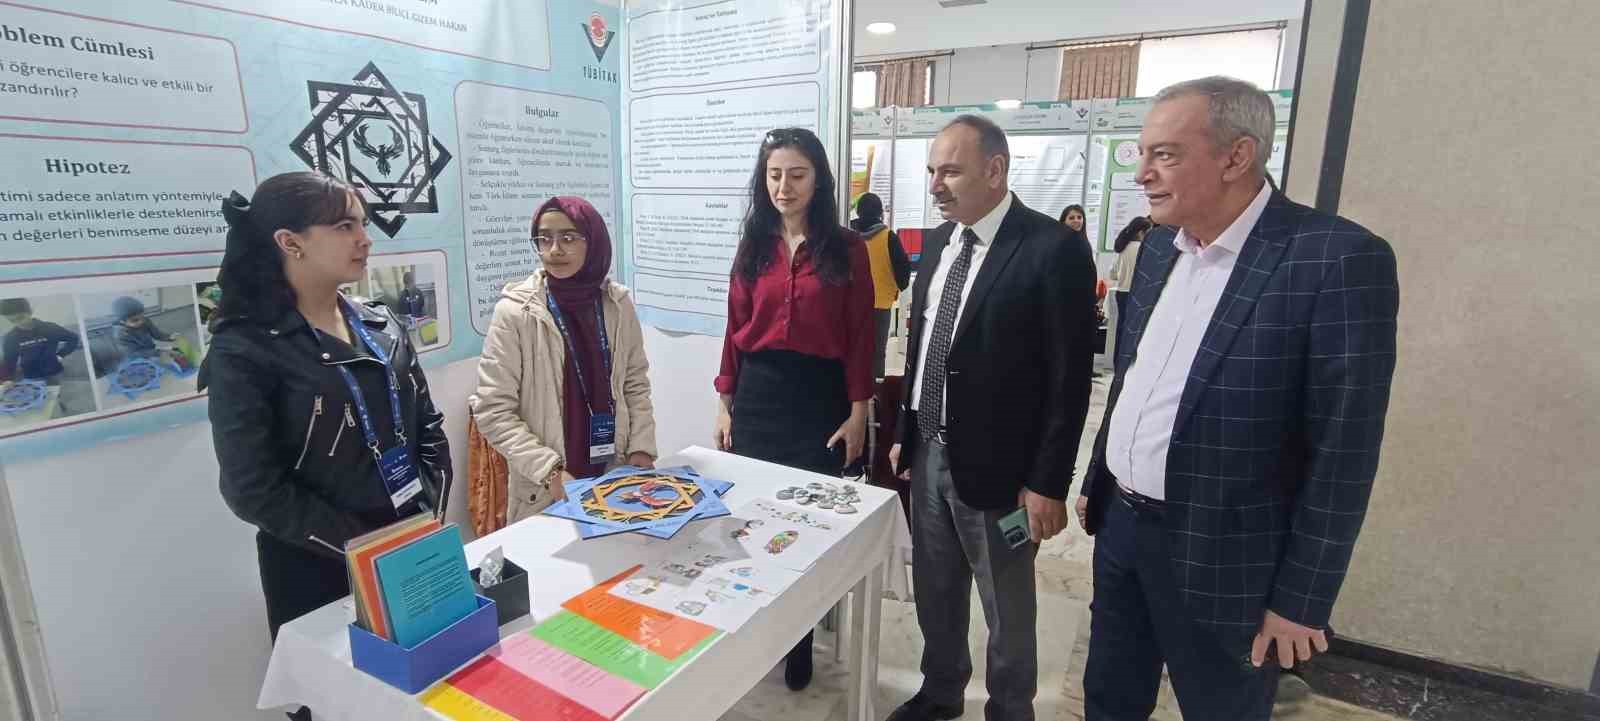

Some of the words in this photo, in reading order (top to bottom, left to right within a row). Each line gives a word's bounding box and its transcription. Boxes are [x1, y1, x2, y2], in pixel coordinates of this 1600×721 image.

[0, 24, 65, 48] blem
[71, 34, 154, 60] Cümlesi
[9, 61, 99, 81] öğrencilere
[102, 71, 138, 86] kalıcı
[142, 79, 158, 88] ve
[162, 79, 194, 92] etkili
[197, 82, 214, 93] bir
[583, 64, 617, 84] TÜBİTAK
[525, 103, 560, 118] Bulgular
[45, 158, 131, 176] Hipotez
[37, 190, 90, 201] sadece
[95, 191, 149, 201] anlatım
[0, 210, 44, 221] amalı
[48, 209, 136, 222] etkinliklerle
[12, 228, 83, 243] değerleri
[88, 226, 169, 239] benimseme
[173, 225, 212, 236] düzeyi
